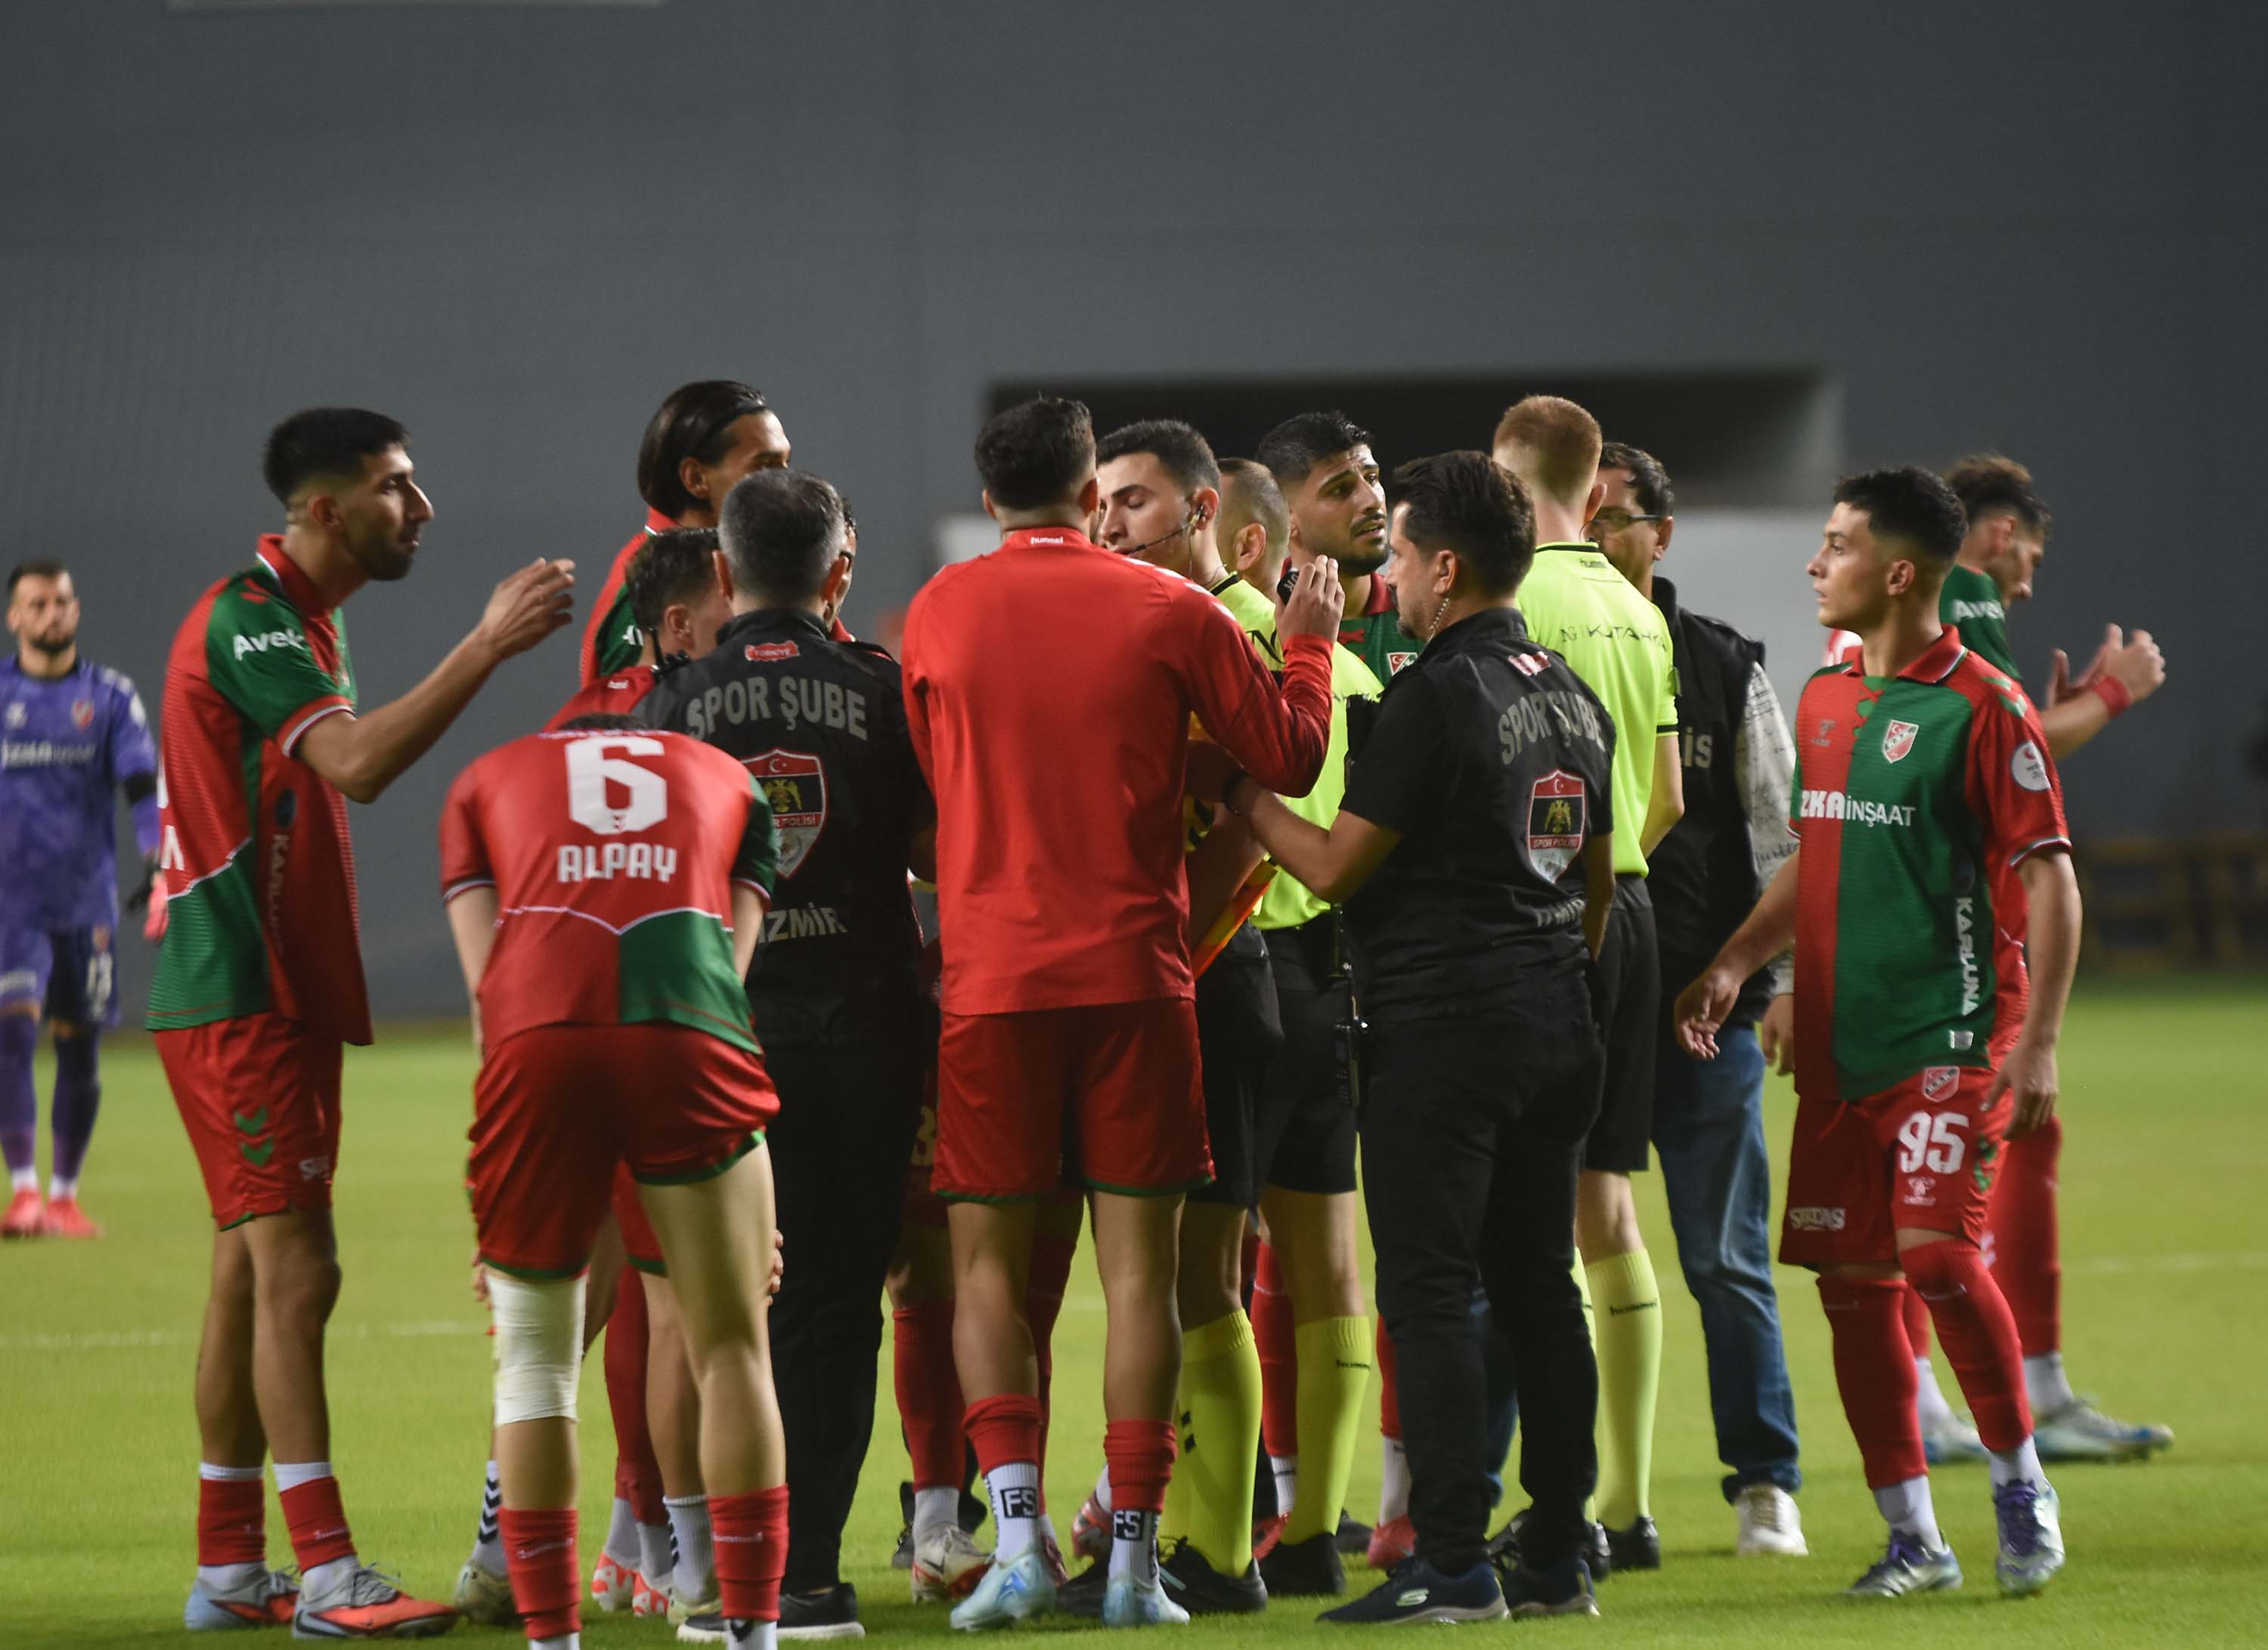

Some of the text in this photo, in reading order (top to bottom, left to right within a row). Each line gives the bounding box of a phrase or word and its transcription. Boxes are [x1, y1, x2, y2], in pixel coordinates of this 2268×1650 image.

[686, 675, 867, 742] SPOR ŞUBE
[1498, 691, 1552, 765] SPOR
[564, 737, 668, 836] 6
[556, 842, 677, 882] ALPAY
[1898, 1111, 1969, 1174] 95
[1004, 1489, 1036, 1516] FS
[1113, 1510, 1142, 1537] FS
